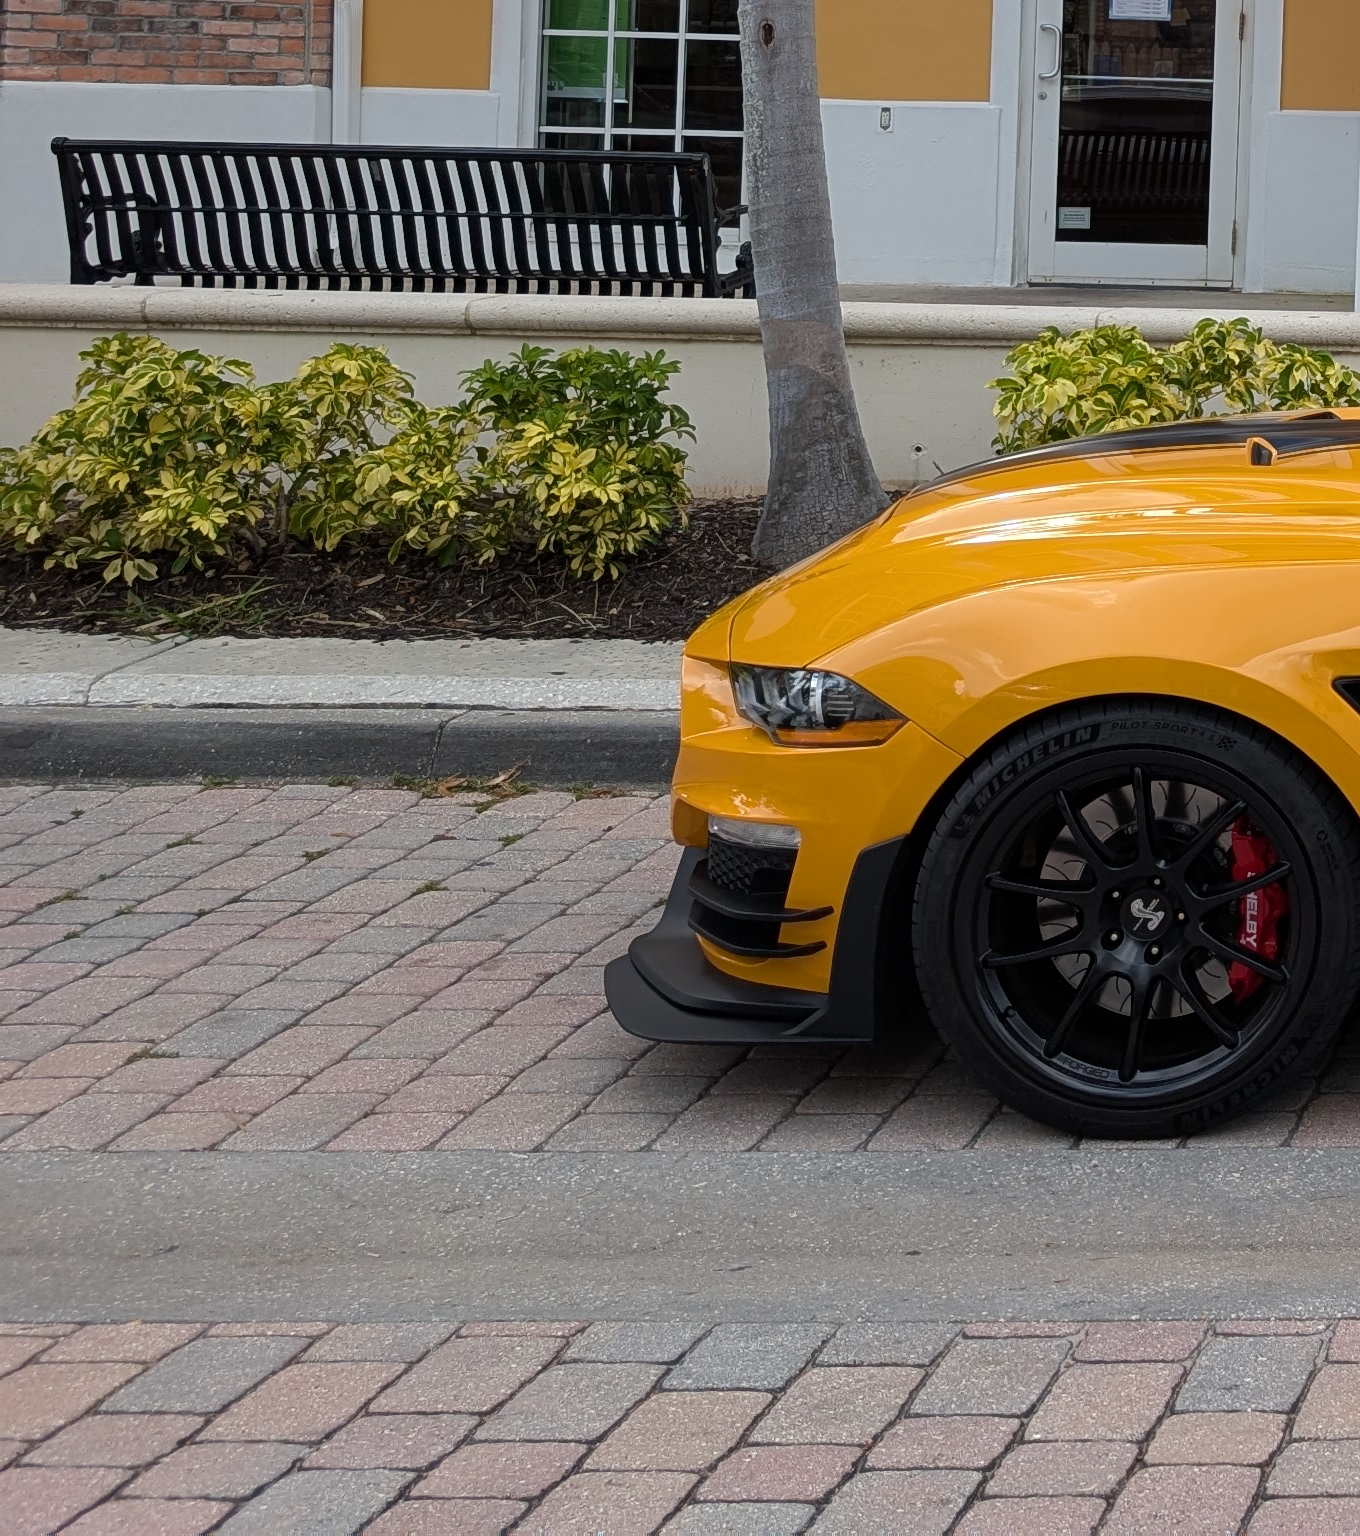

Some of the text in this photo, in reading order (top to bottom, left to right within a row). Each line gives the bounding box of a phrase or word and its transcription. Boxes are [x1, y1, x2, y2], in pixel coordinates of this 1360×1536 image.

[1111, 720, 1149, 732] PILOT
[1153, 720, 1198, 738] SPORT
[974, 725, 1093, 814] MICHELIN
[1062, 1056, 1111, 1079] FORGED
